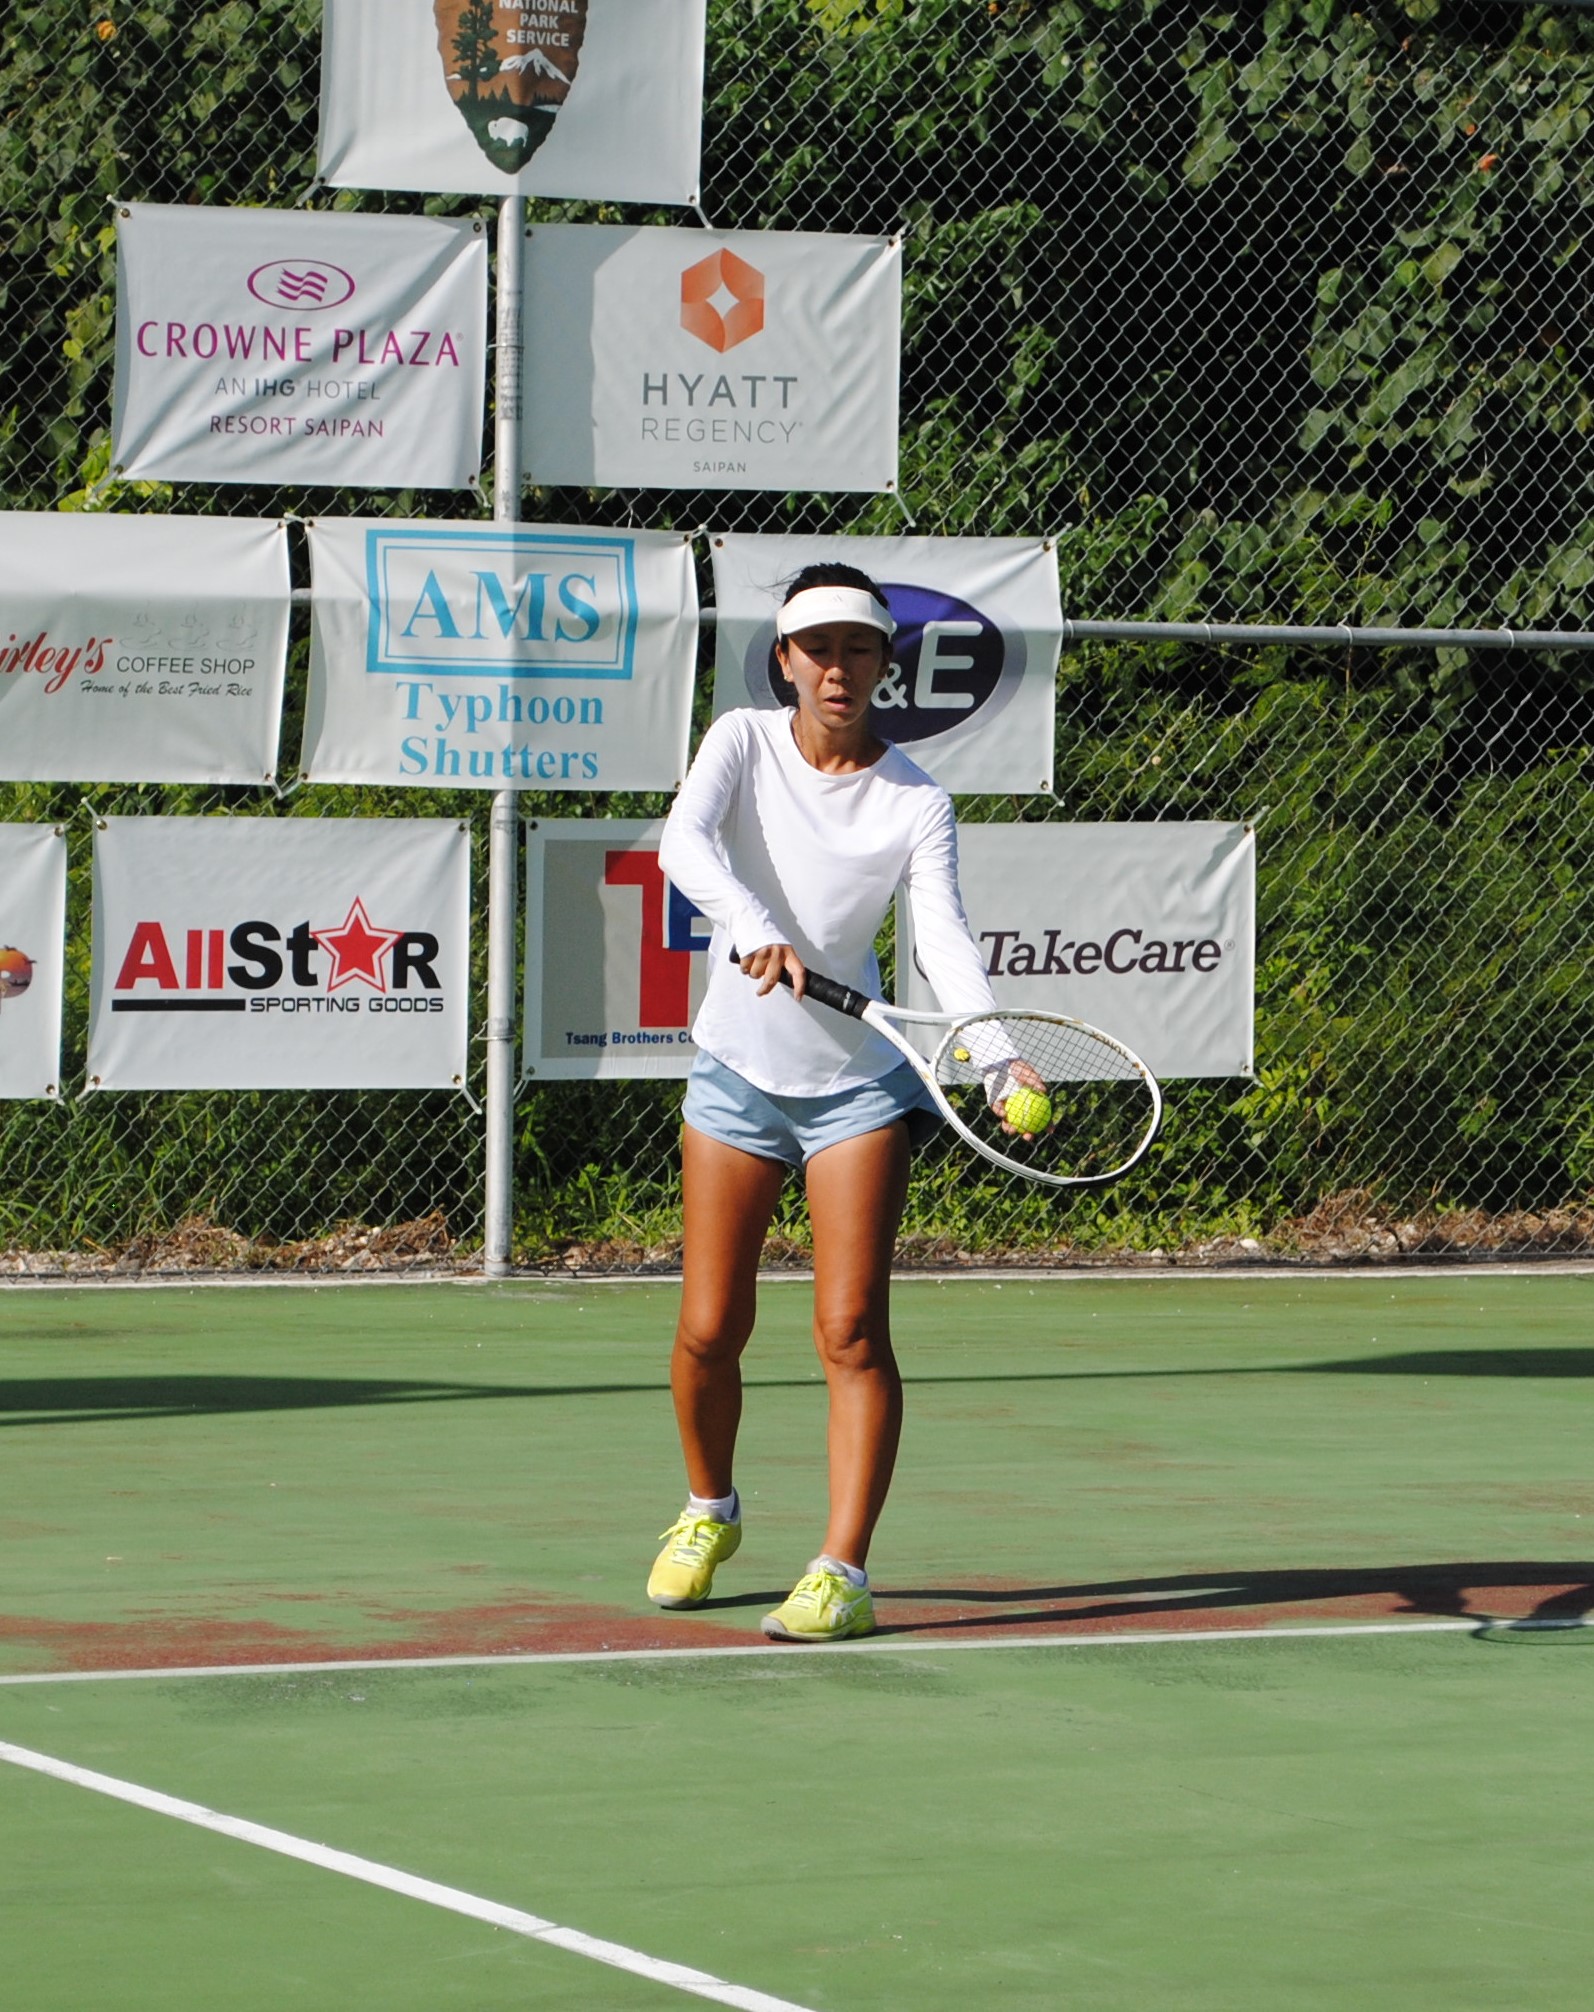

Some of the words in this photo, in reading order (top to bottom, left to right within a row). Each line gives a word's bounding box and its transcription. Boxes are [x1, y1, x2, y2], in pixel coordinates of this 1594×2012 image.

[498, 0, 579, 13] NATIONAL
[520, 13, 559, 29] PARK
[506, 28, 570, 47] SERVICE
[137, 321, 312, 363] CROWNE
[332, 328, 460, 367] PLAZA
[214, 377, 246, 396] AN
[255, 378, 296, 397] IHG
[307, 379, 381, 400] HOTEL
[642, 372, 798, 409] HYATT
[209, 415, 297, 436] RESORT
[304, 418, 384, 438] SAIPAN
[641, 417, 799, 444] REGENCY
[692, 460, 747, 474] SAIPAN
[401, 569, 601, 644] AMS
[116, 656, 195, 674] COFFEE
[200, 657, 256, 675] SHOP
[80, 679, 115, 694] Home
[118, 681, 132, 698] of
[134, 681, 153, 694] the
[158, 680, 185, 695] Best
[188, 681, 222, 698] Fried
[225, 682, 253, 697] Rice
[396, 681, 605, 733] Typhoon
[399, 735, 599, 780] Shutters
[978, 928, 1222, 976] TakeCare
[250, 997, 360, 1012] SPORTING
[368, 997, 444, 1013] GOODS
[566, 1031, 608, 1047] Tsang
[612, 1031, 674, 1044] Brothers
